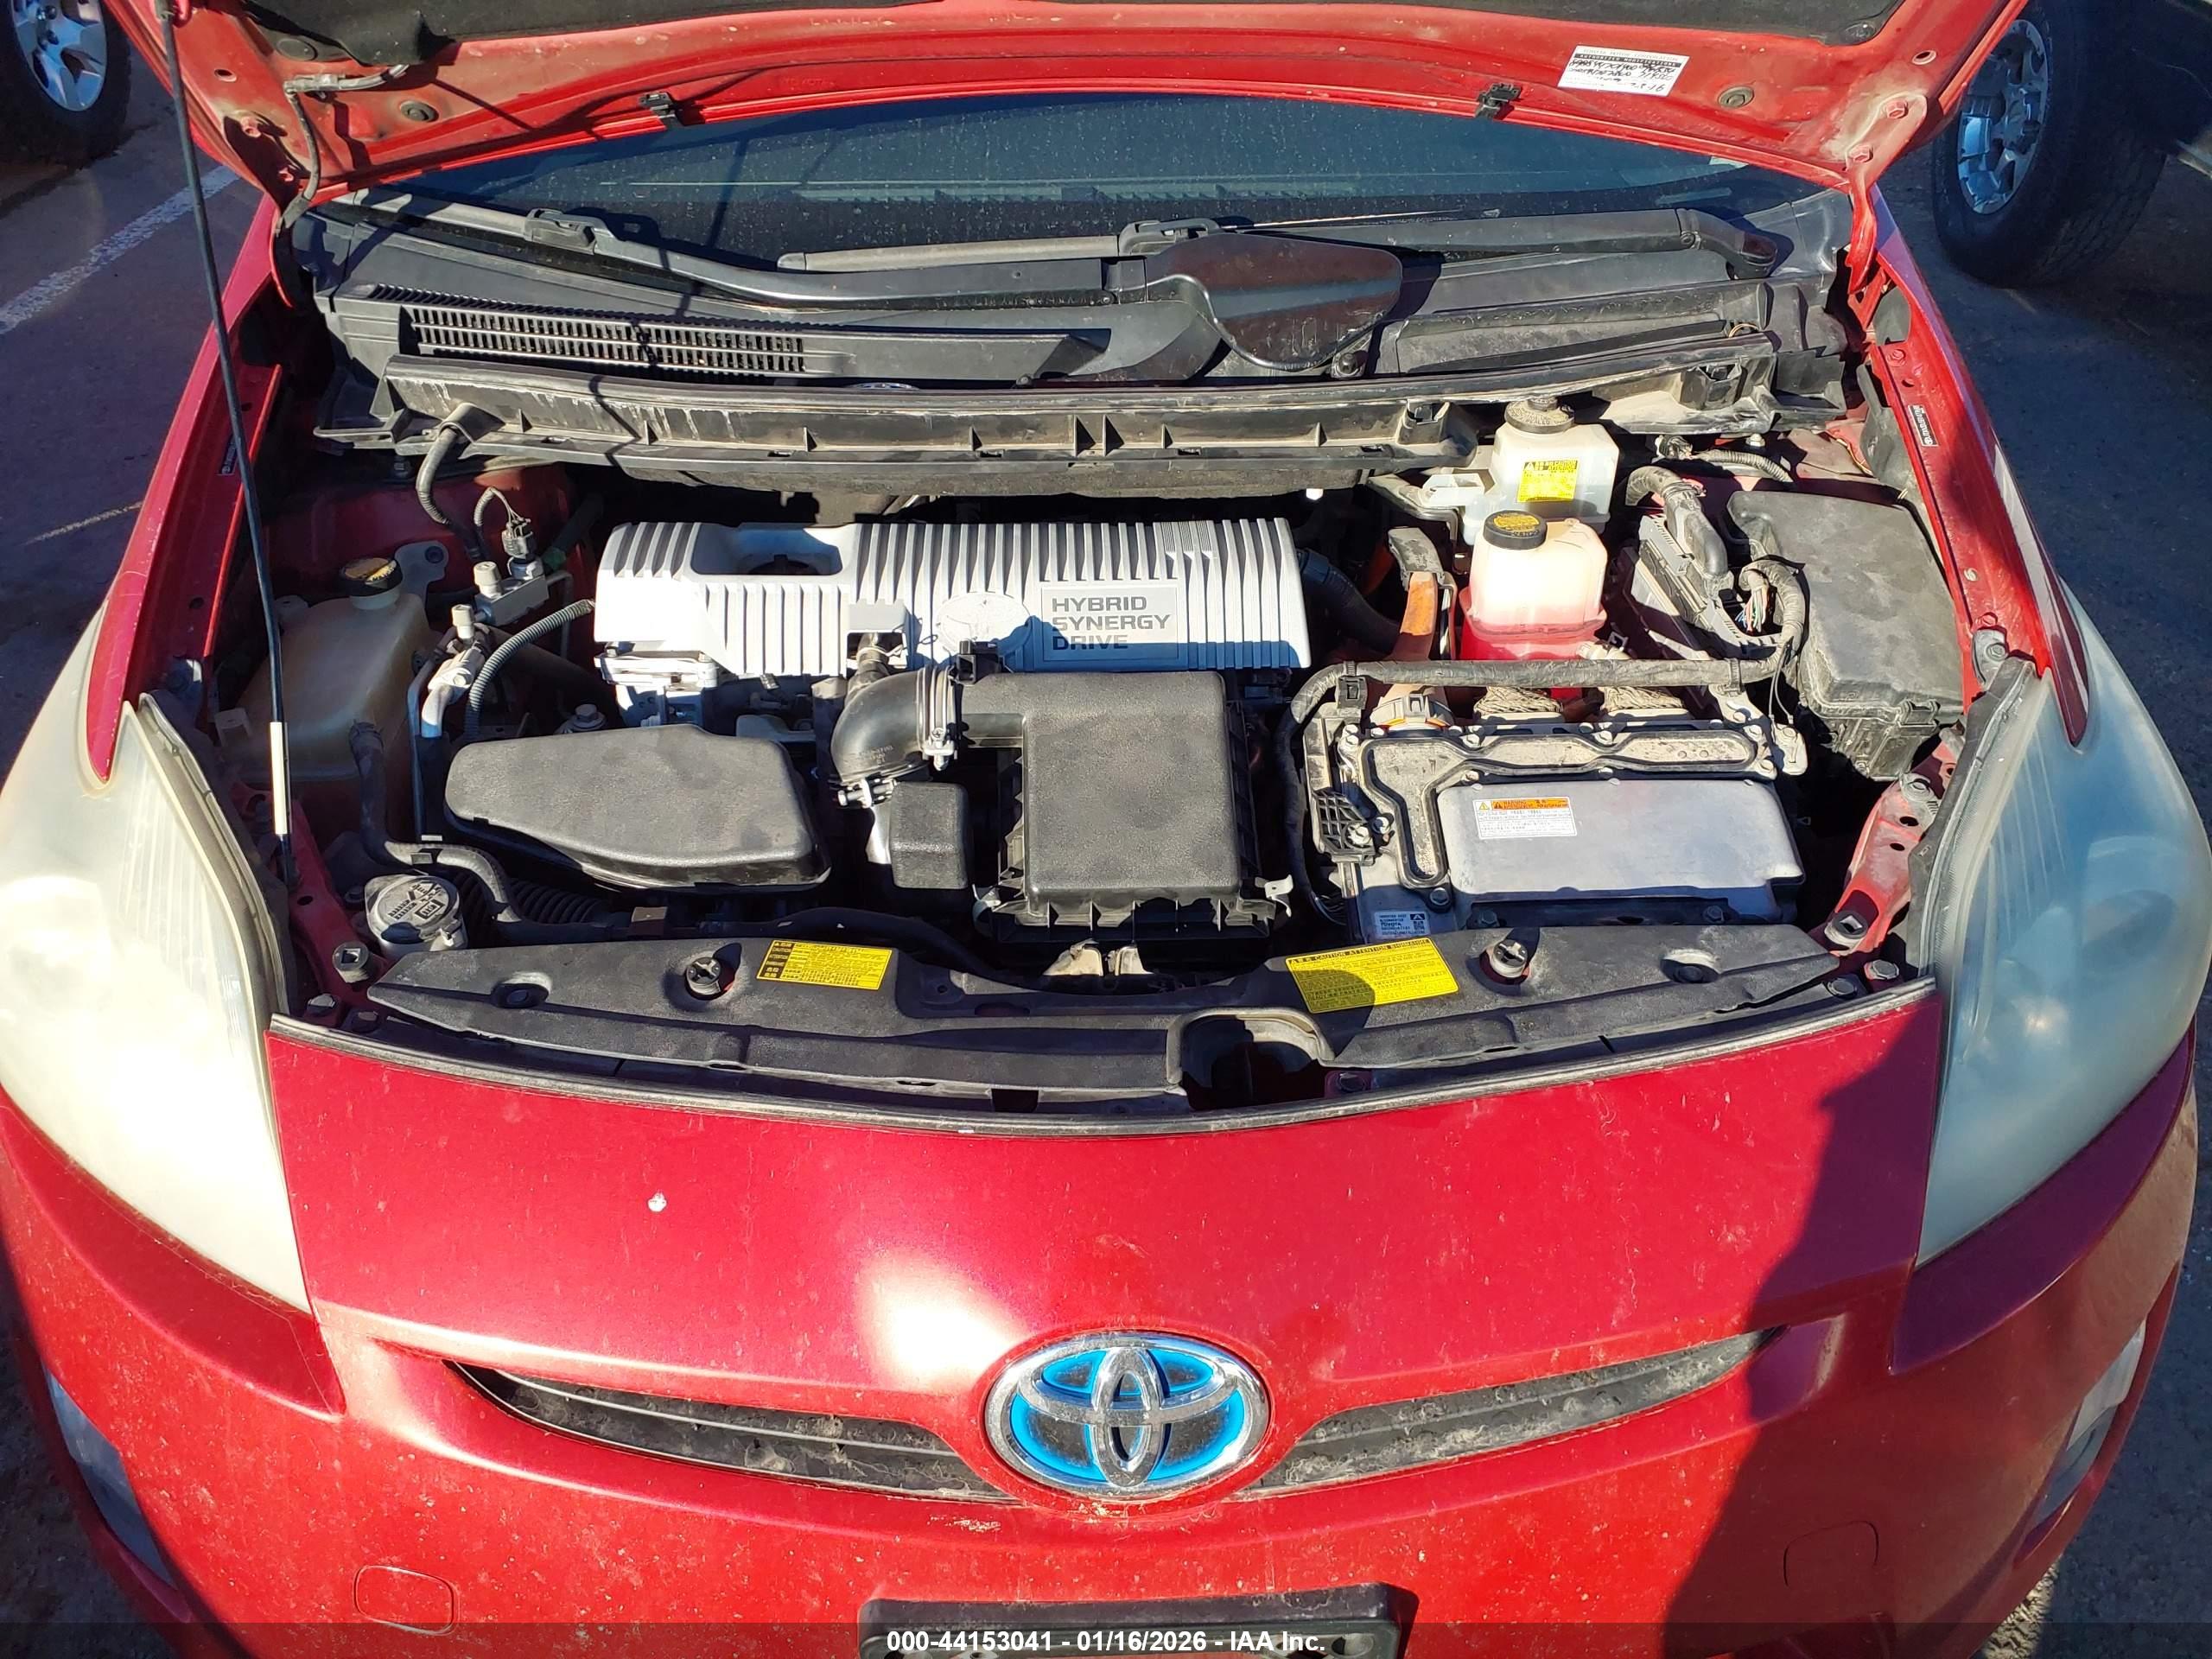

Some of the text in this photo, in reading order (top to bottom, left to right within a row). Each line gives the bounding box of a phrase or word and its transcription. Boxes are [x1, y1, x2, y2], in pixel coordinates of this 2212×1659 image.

[1052, 596, 1147, 612] HYBRID
[1052, 614, 1171, 632] SYNERGY
[1052, 634, 1129, 651] DRIVE
[1315, 951, 1345, 960] CAUTION
[1350, 945, 1384, 955] ATTENTION
